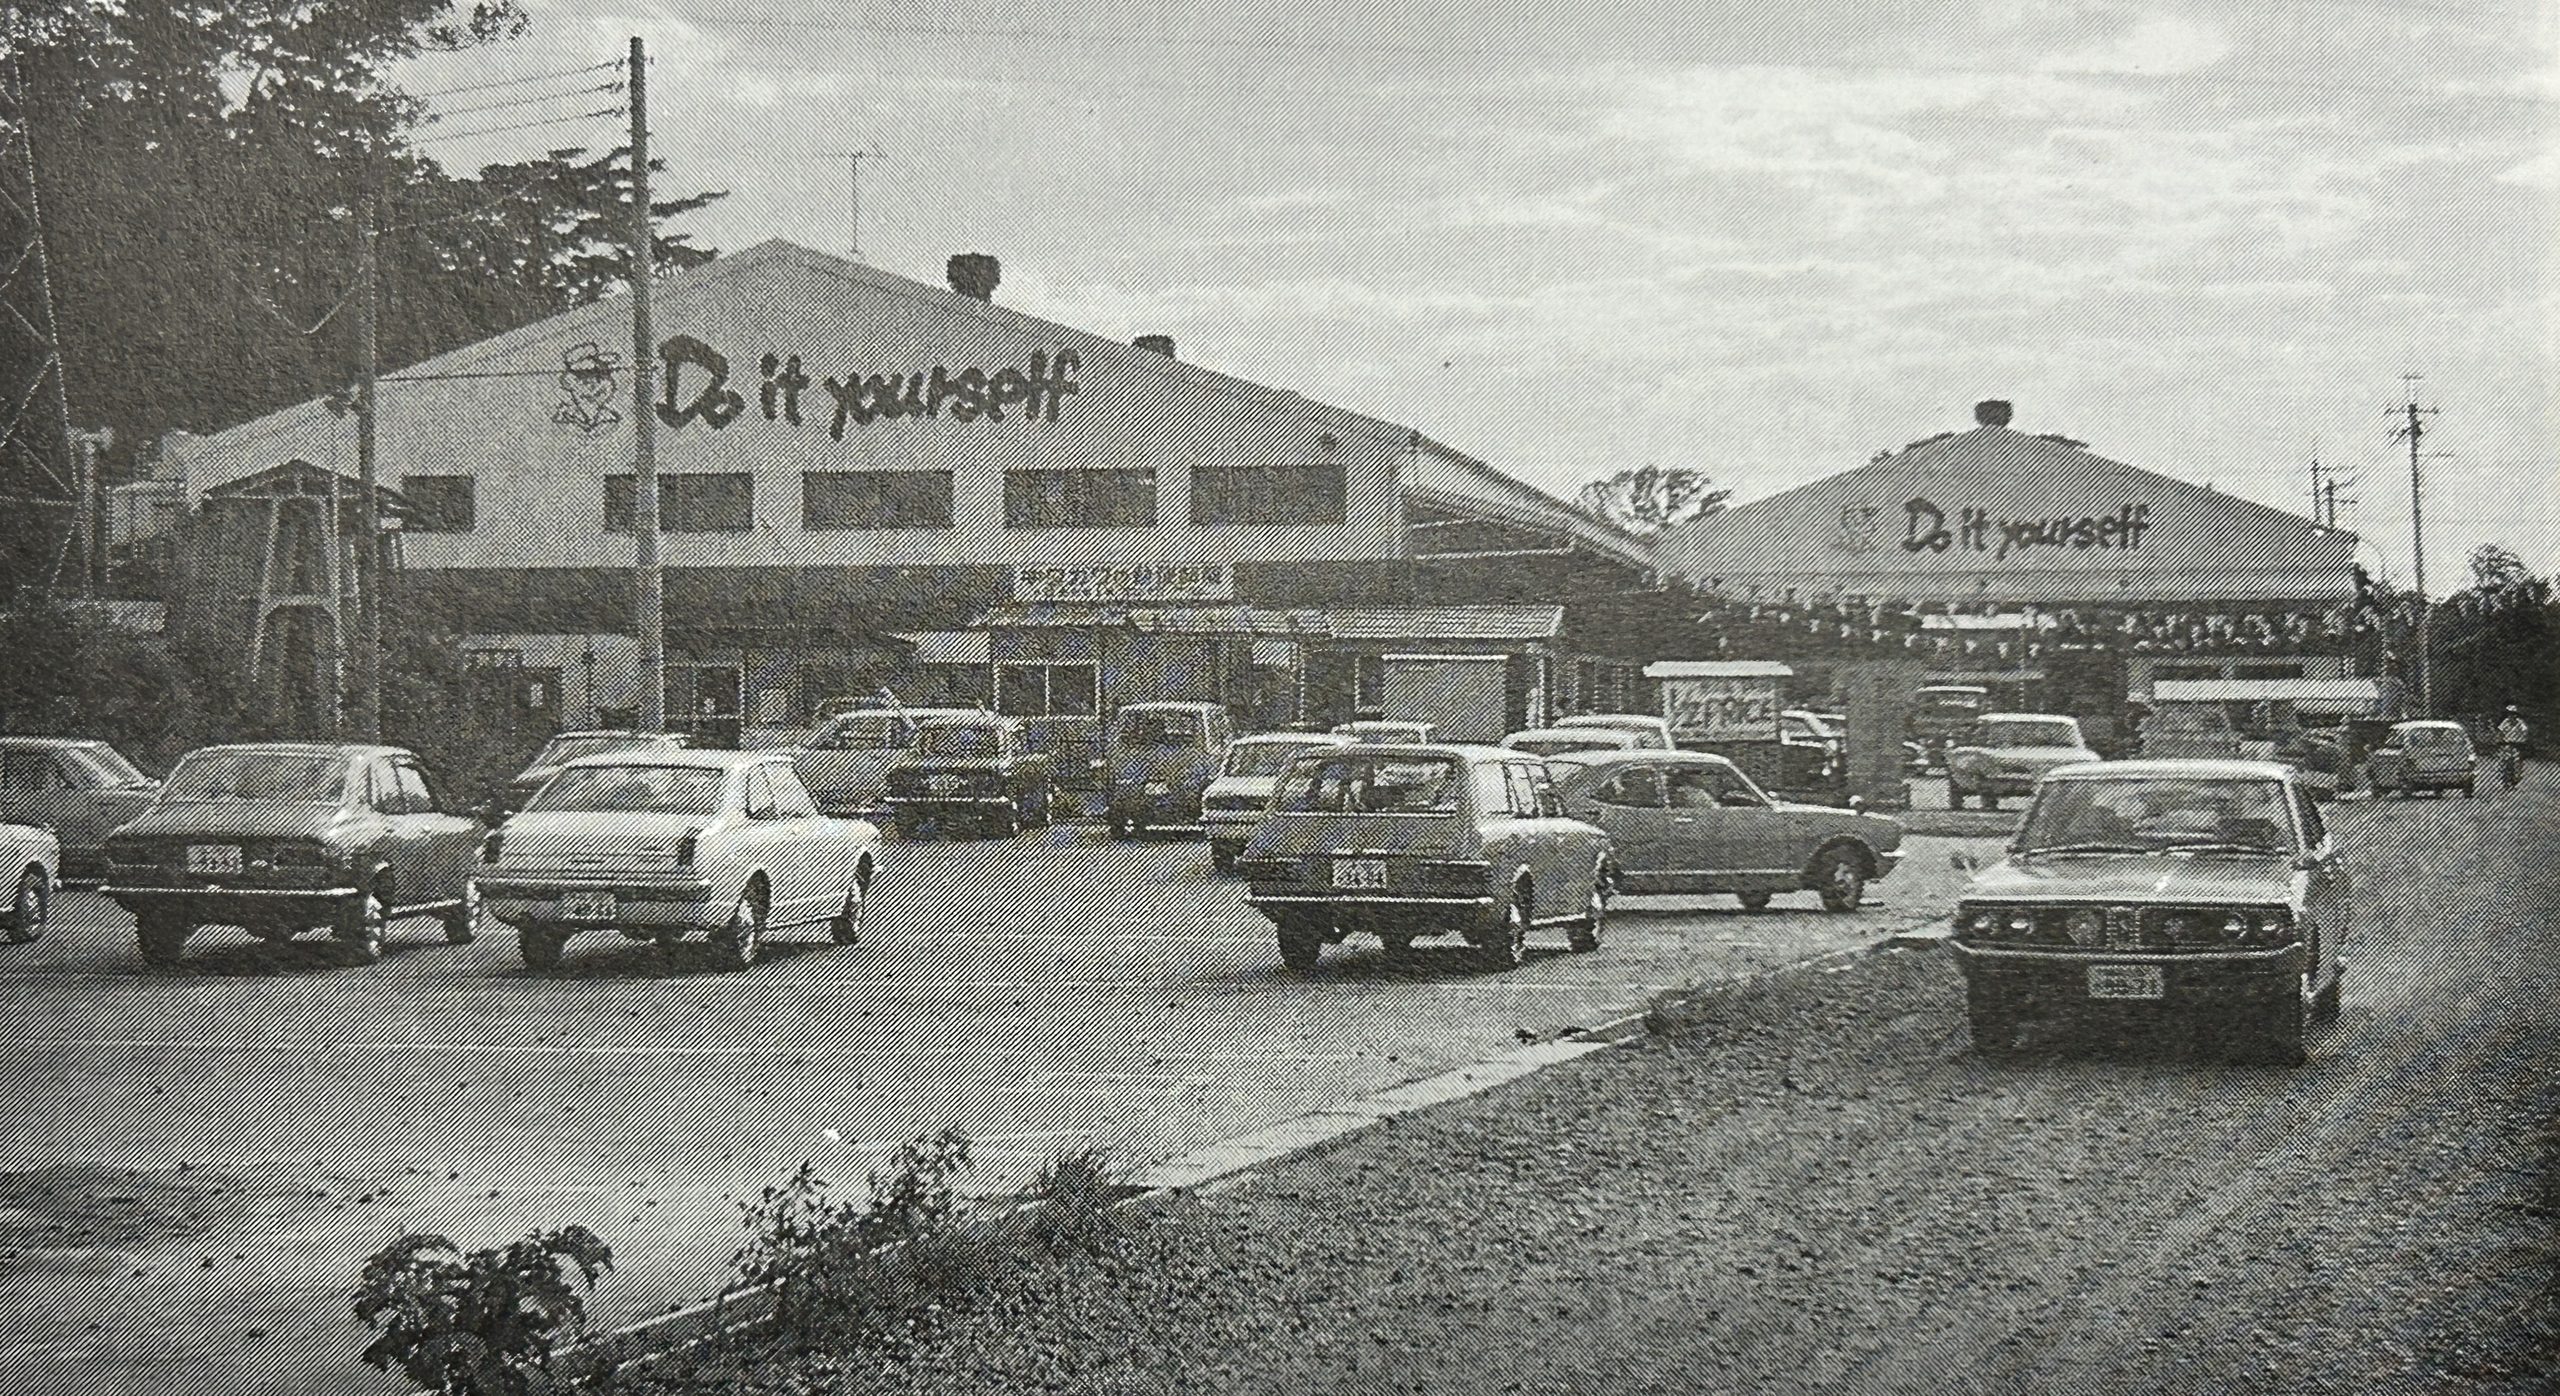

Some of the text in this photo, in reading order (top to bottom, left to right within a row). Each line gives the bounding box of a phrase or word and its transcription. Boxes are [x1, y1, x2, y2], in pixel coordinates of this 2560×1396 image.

[655, 333, 1080, 442] Do it yourself
[1900, 497, 2149, 562] Do it yourself
